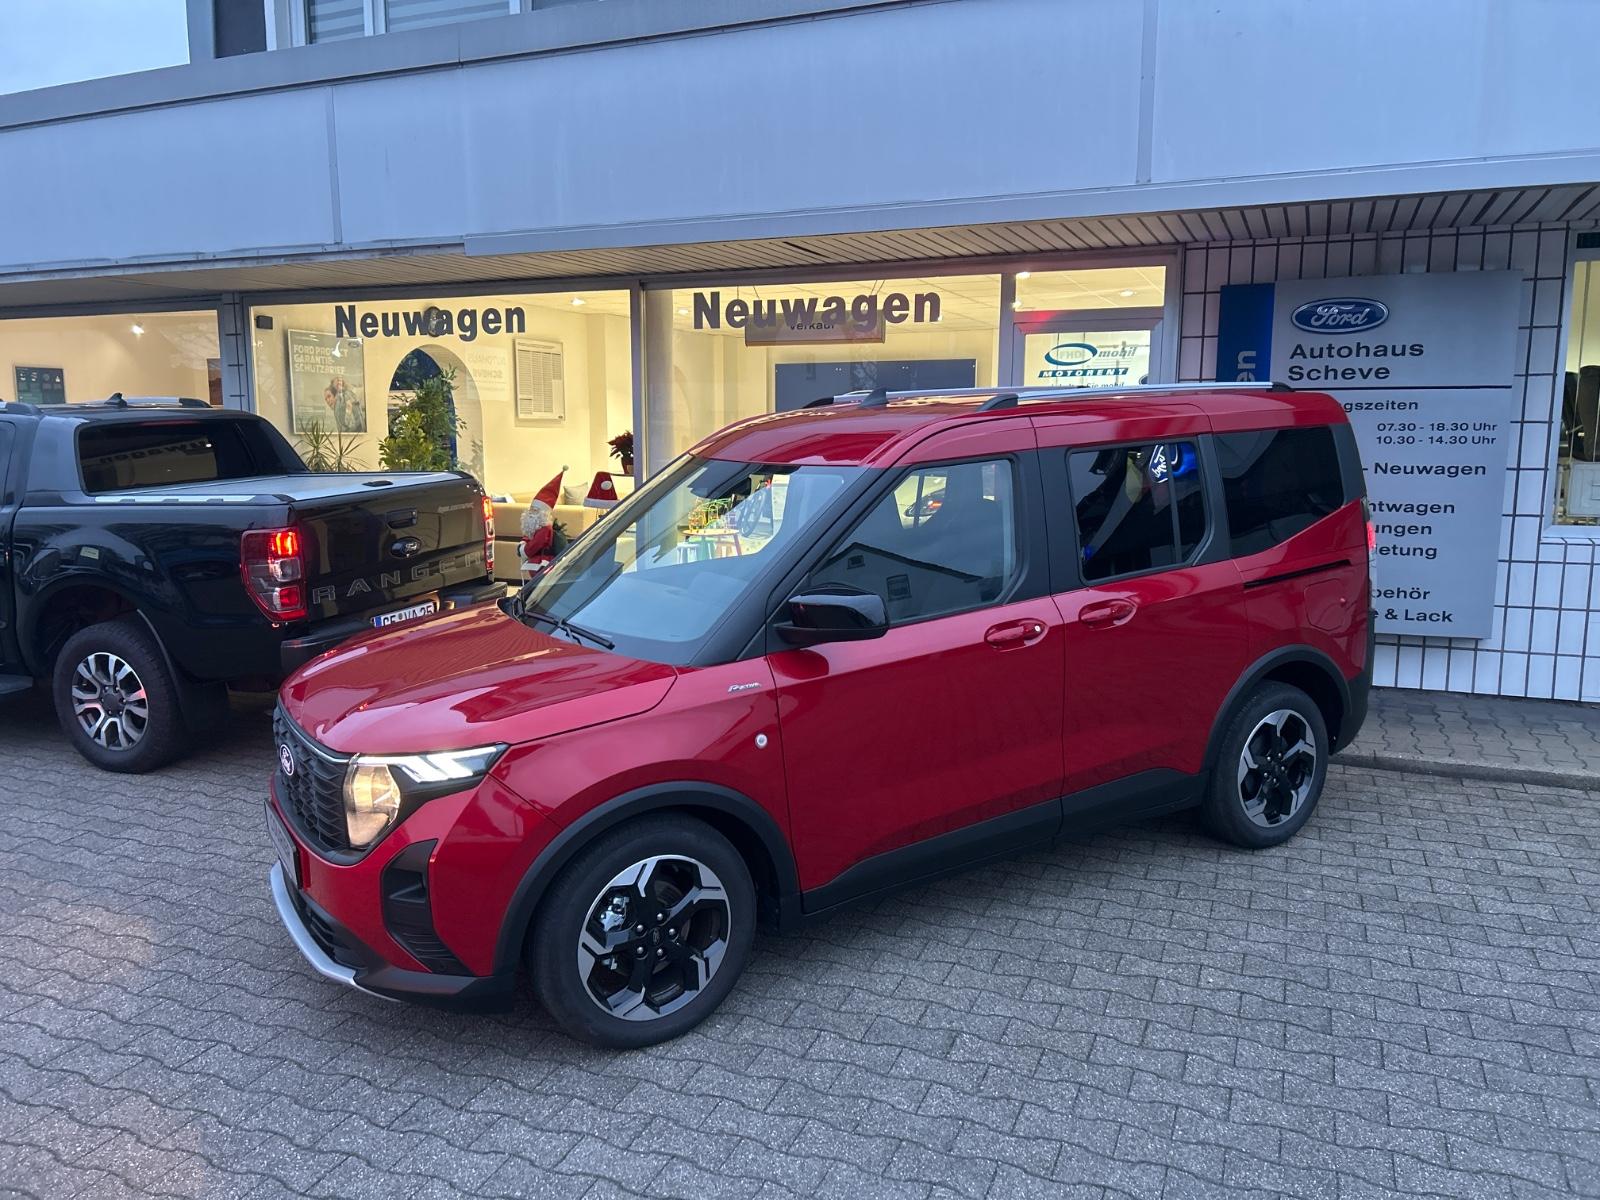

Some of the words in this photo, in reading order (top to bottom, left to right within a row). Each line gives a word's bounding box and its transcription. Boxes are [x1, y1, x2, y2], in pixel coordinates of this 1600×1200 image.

[693, 291, 941, 333] Neuwagen
[1310, 304, 1370, 327] Ford
[335, 304, 525, 342] Neuwagen
[294, 344, 315, 355] FORD
[1099, 346, 1137, 359] mobil
[1290, 342, 1424, 360] Autohaus
[1042, 368, 1126, 378] MOTORENT
[1288, 365, 1390, 381] Scheve
[1344, 400, 1419, 413] gszeiten
[1377, 423, 1416, 432] 07.30
[1430, 423, 1469, 432] 18.30
[1473, 422, 1498, 431] Uhr
[1376, 436, 1416, 445] 10.30
[1429, 436, 1468, 445] 14.30
[1472, 436, 1497, 445] Uhr
[1374, 462, 1487, 478] Neuwagen
[312, 551, 481, 605] RANGER
[1384, 608, 1398, 620] &
[1404, 609, 1454, 622] Lack
